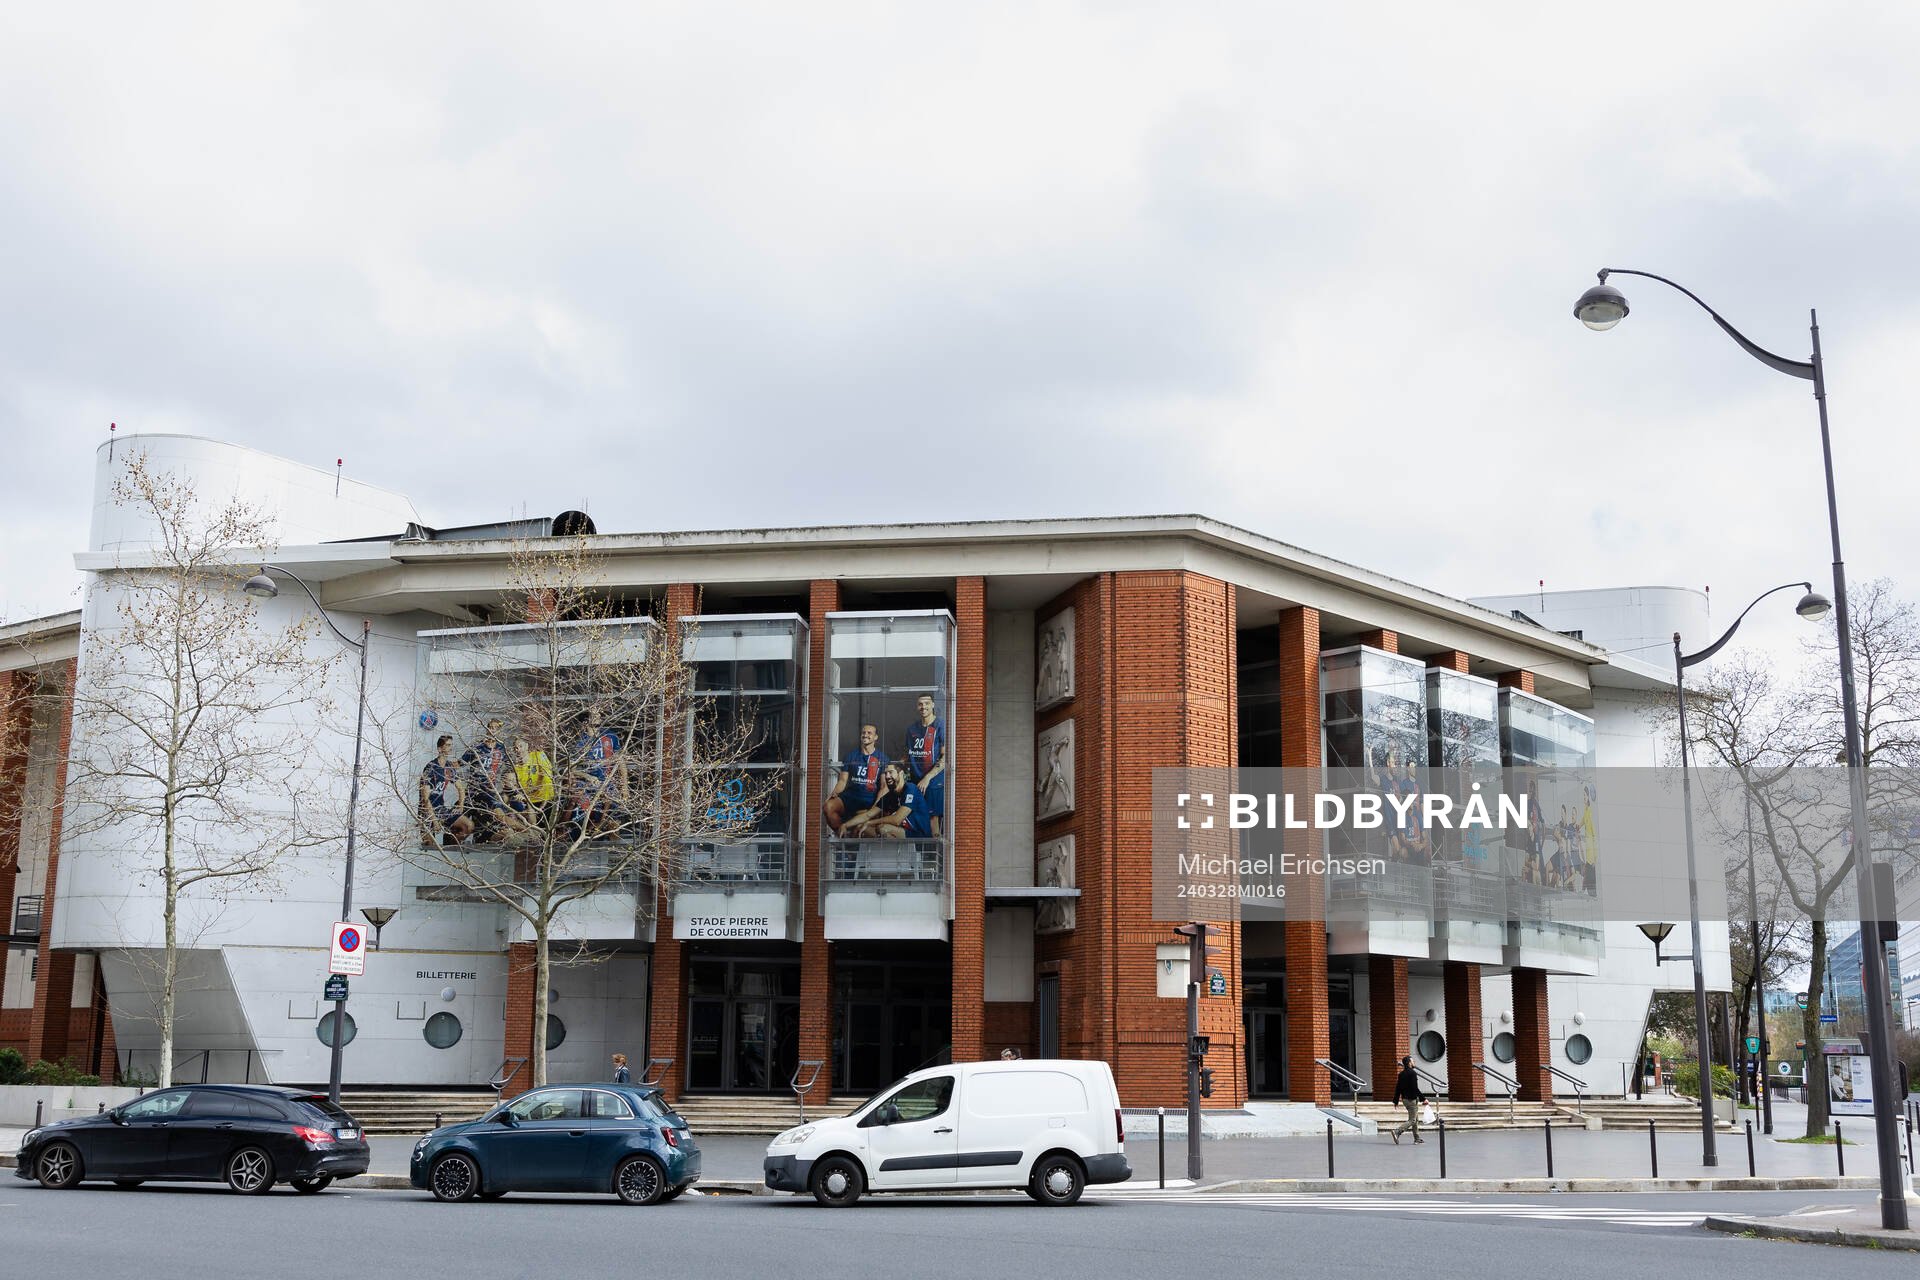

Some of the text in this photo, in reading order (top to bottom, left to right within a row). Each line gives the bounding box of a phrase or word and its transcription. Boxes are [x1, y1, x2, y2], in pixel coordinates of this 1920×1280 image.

[913, 738, 924, 749] 20
[857, 766, 868, 776] 15
[690, 917, 768, 926] STADE PIERRE
[690, 928, 768, 937] DE COUBERTIN
[416, 971, 477, 980] BILLETTERIE
